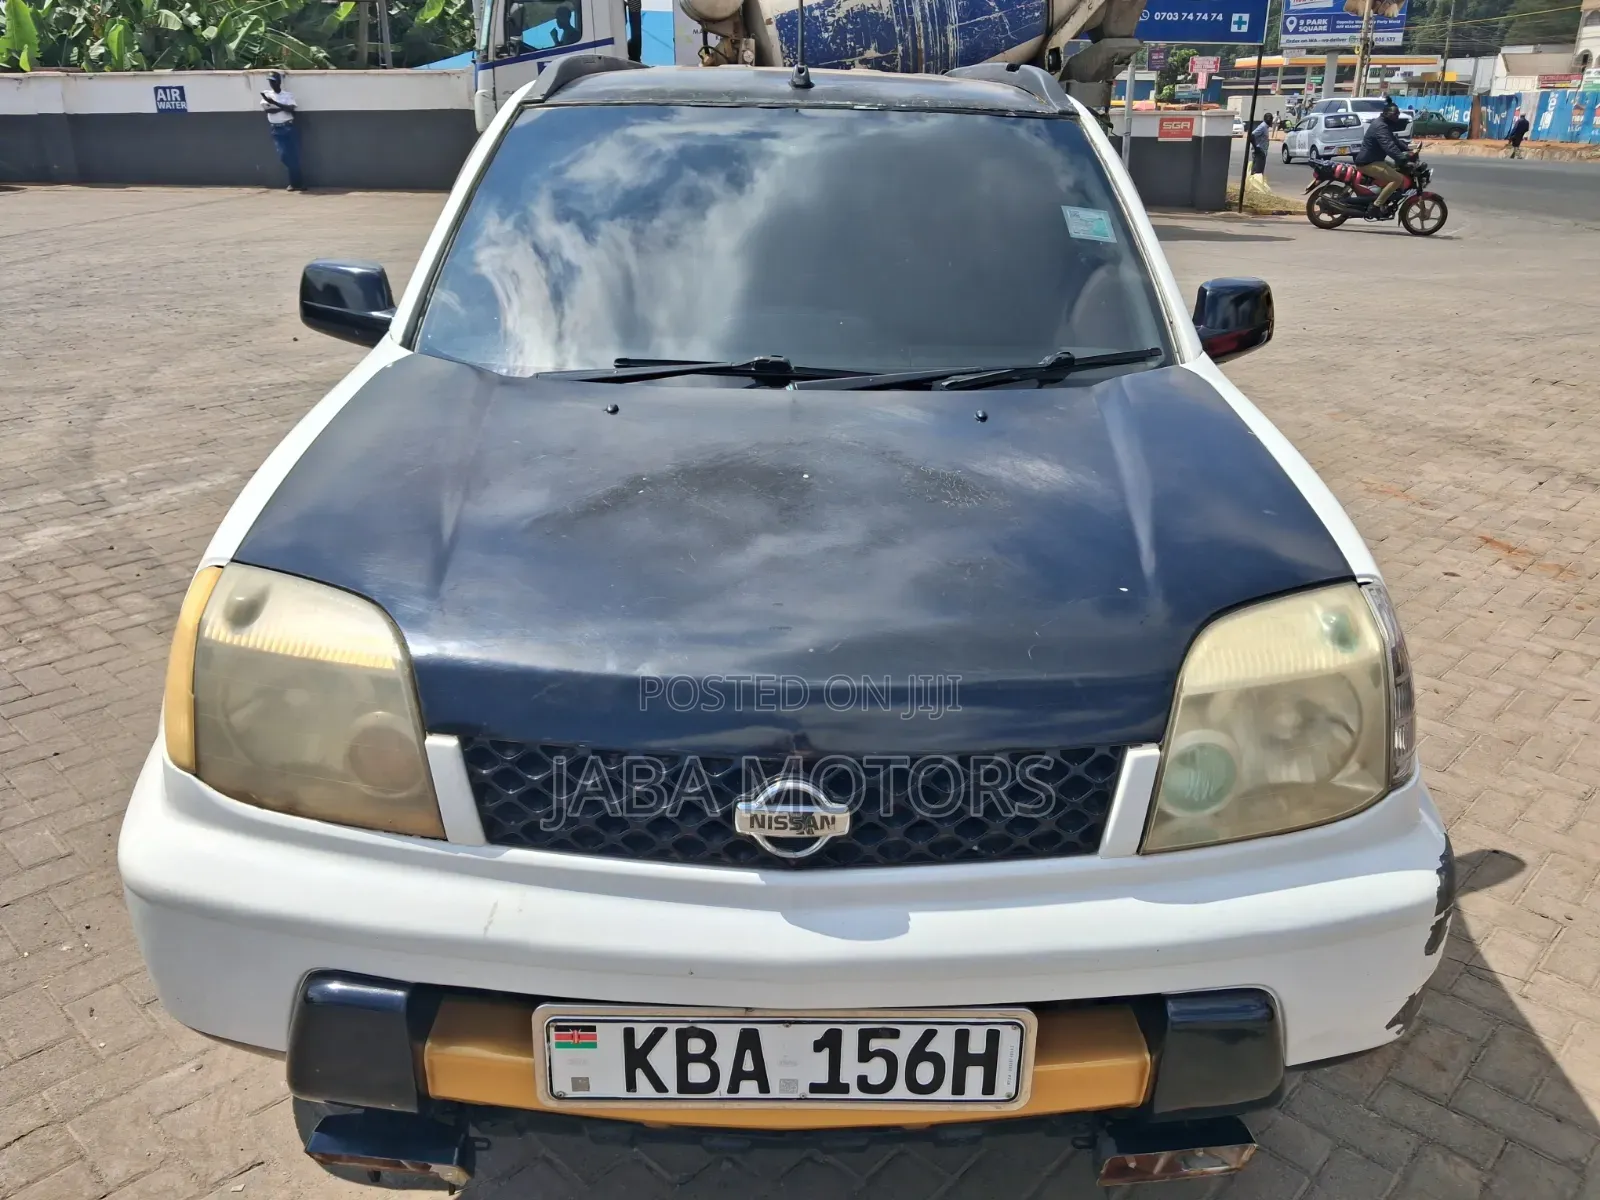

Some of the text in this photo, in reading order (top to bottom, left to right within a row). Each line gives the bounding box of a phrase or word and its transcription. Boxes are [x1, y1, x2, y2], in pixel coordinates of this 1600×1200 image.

[1154, 12, 1224, 21] 0703 74 74 74
[156, 88, 181, 101] AIR
[157, 101, 187, 110] WATER
[1162, 121, 1191, 130] SGA
[749, 813, 836, 831] NISSAN
[622, 1026, 771, 1095] KBA
[808, 1027, 1001, 1096] 156H
